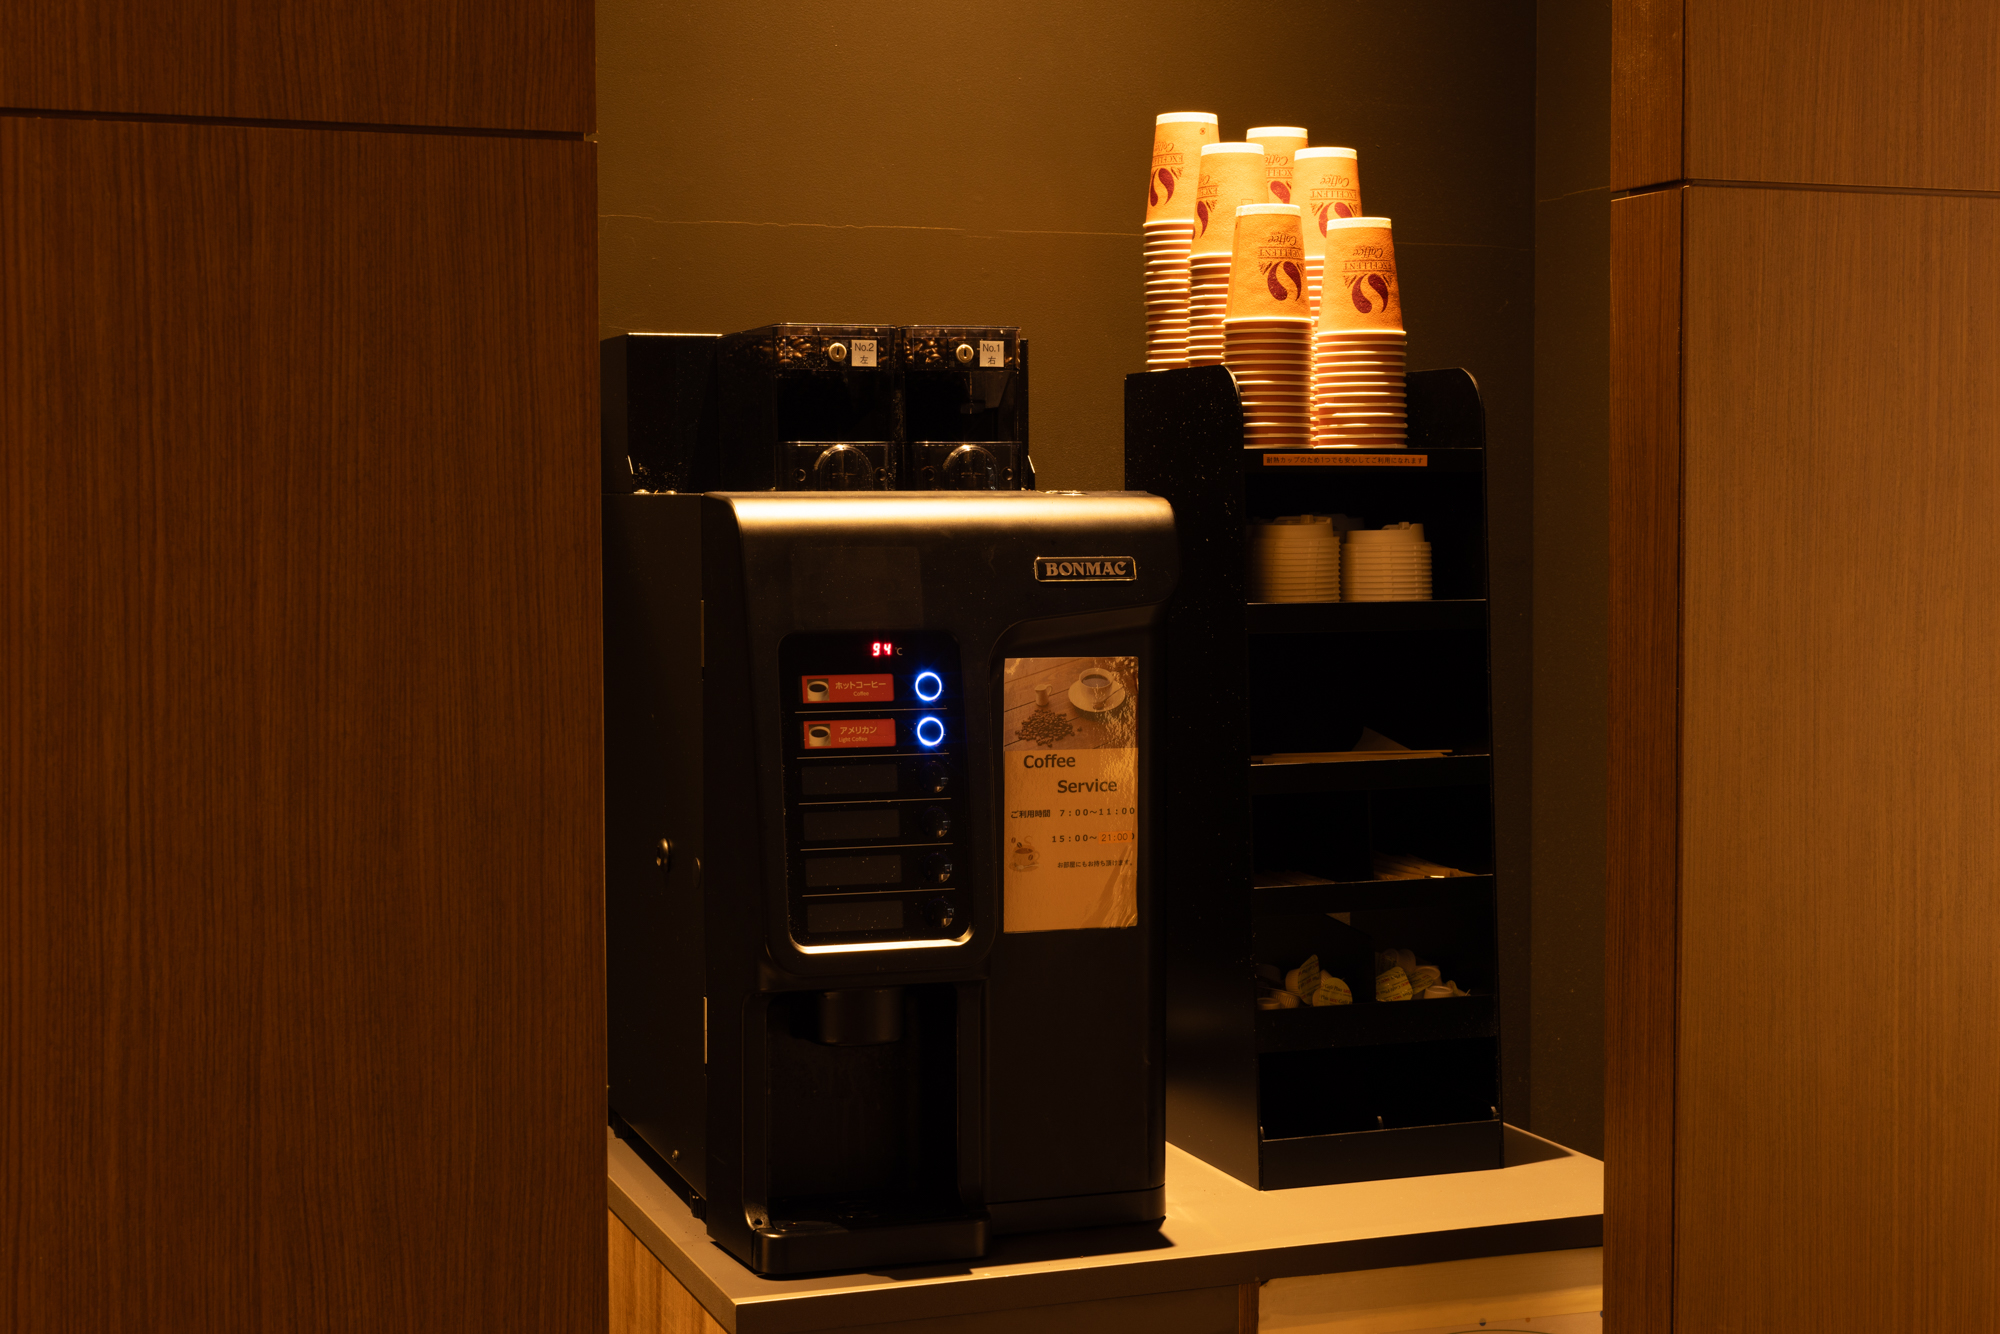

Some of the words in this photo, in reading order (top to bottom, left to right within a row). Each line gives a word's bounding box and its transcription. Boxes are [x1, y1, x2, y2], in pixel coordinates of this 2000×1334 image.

[1265, 154, 1289, 166] Coffe
[1266, 169, 1293, 177] XCELL
[1320, 175, 1350, 187] Coffee
[1268, 234, 1297, 246] Coffee
[1353, 246, 1384, 259] Coffee
[854, 342, 875, 352] No.2
[982, 344, 1001, 353] No.1
[859, 355, 869, 365] 左
[987, 356, 996, 365] 右
[1044, 561, 1127, 577] BONMAC
[872, 642, 892, 656] 94
[835, 681, 887, 690] ホットコーヒー
[840, 726, 878, 735] アメリカン
[1023, 754, 1076, 769] Coffee
[1057, 779, 1118, 793] Service
[1010, 809, 1051, 819] ご利用時間
[1101, 832, 1129, 842] 21:00
